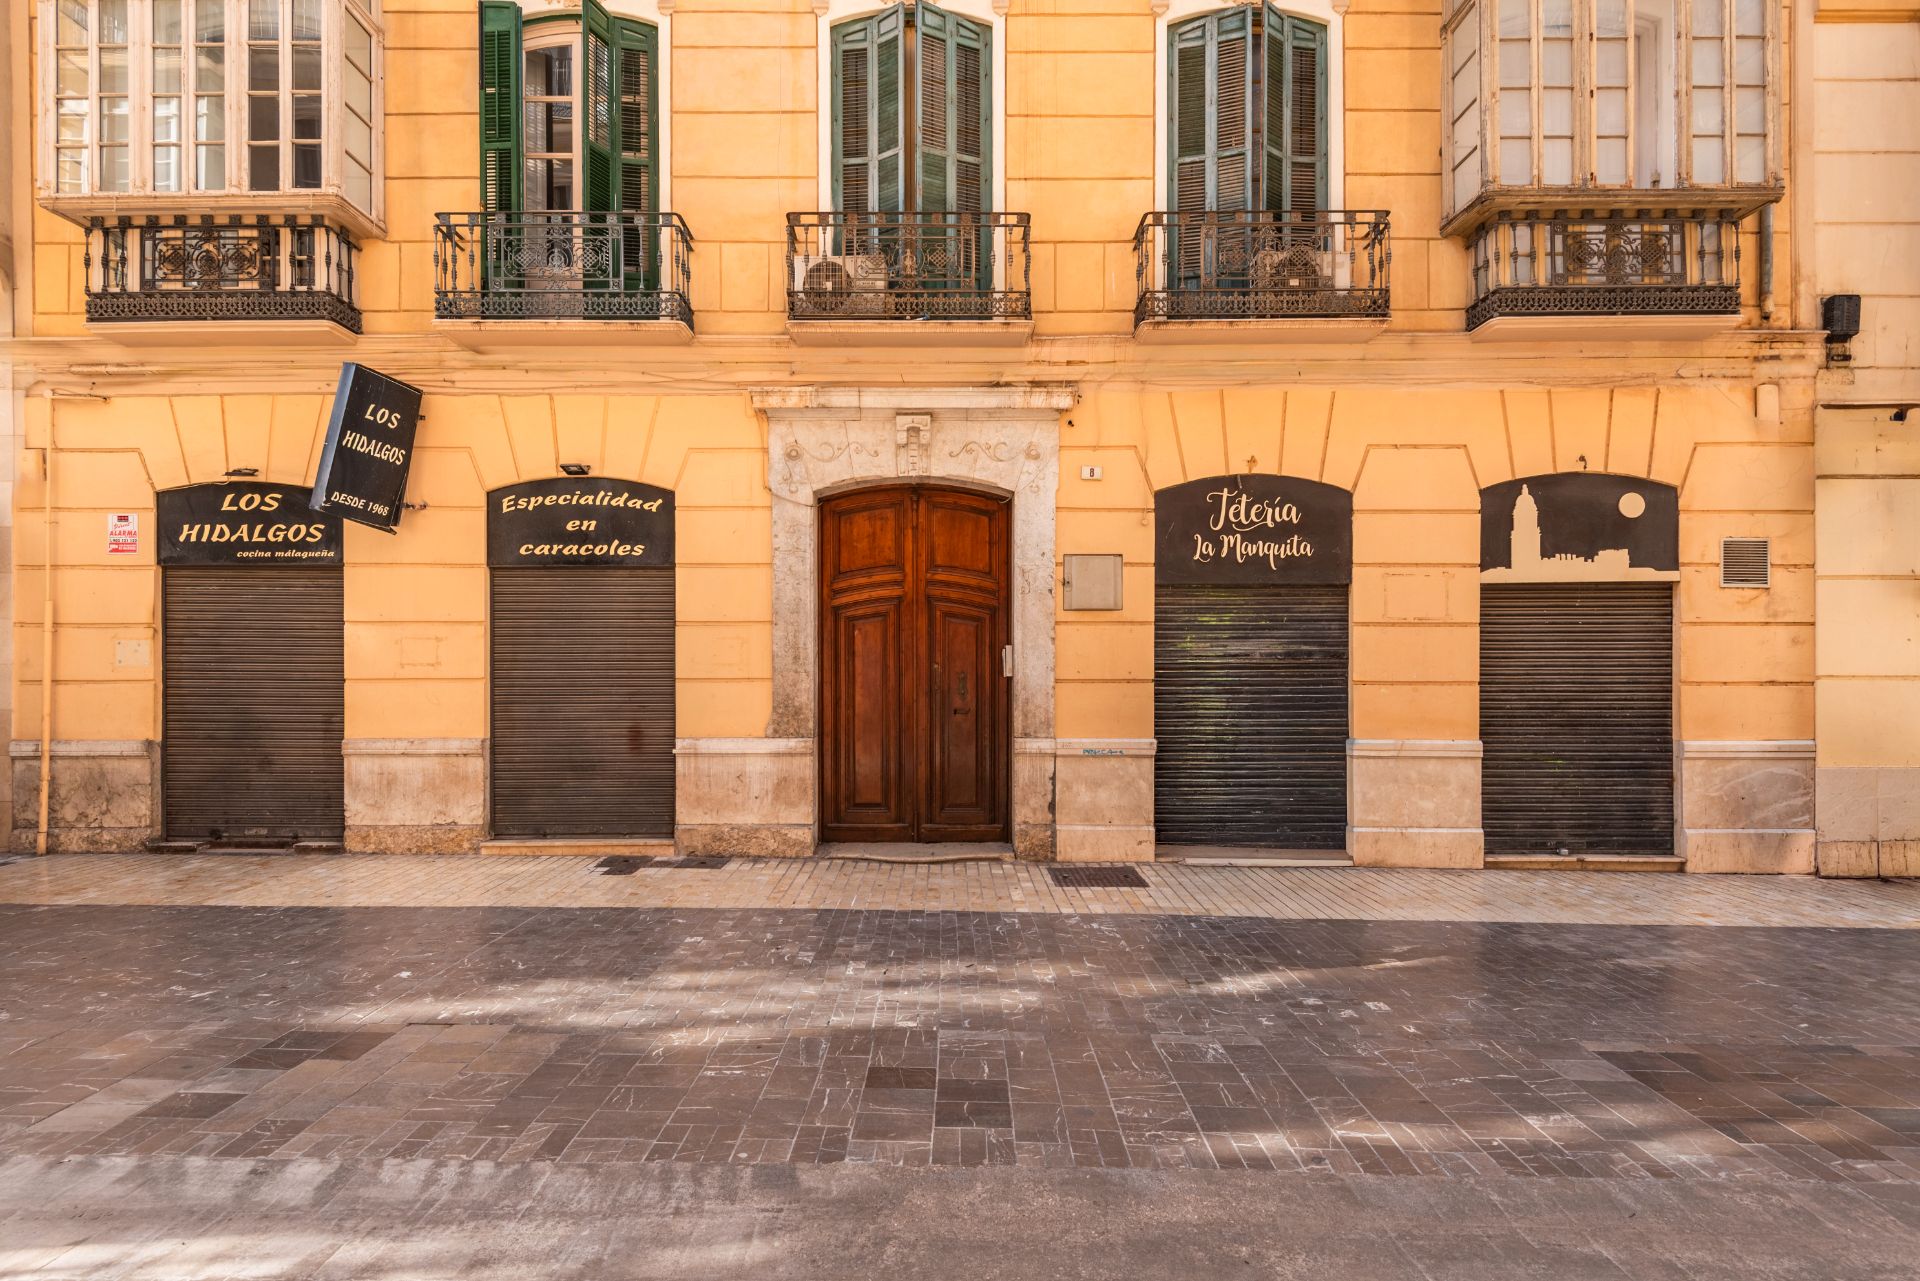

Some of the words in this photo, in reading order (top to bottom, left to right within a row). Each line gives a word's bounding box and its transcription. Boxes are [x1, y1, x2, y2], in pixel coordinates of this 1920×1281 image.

[364, 403, 401, 429] LOS
[342, 430, 406, 466] HIDALGOS
[1089, 467, 1095, 478] 8
[220, 493, 283, 512] LOS
[330, 491, 367, 510] DESDE
[367, 501, 390, 516] 1968
[502, 490, 663, 514] Especialidad
[1206, 487, 1302, 531] Tetería
[178, 523, 326, 543] HIDALGOS
[565, 519, 598, 532] en
[236, 549, 272, 558] cocina
[518, 539, 646, 557] caracoles
[1193, 533, 1216, 563] La
[1219, 533, 1315, 571] Manquita
